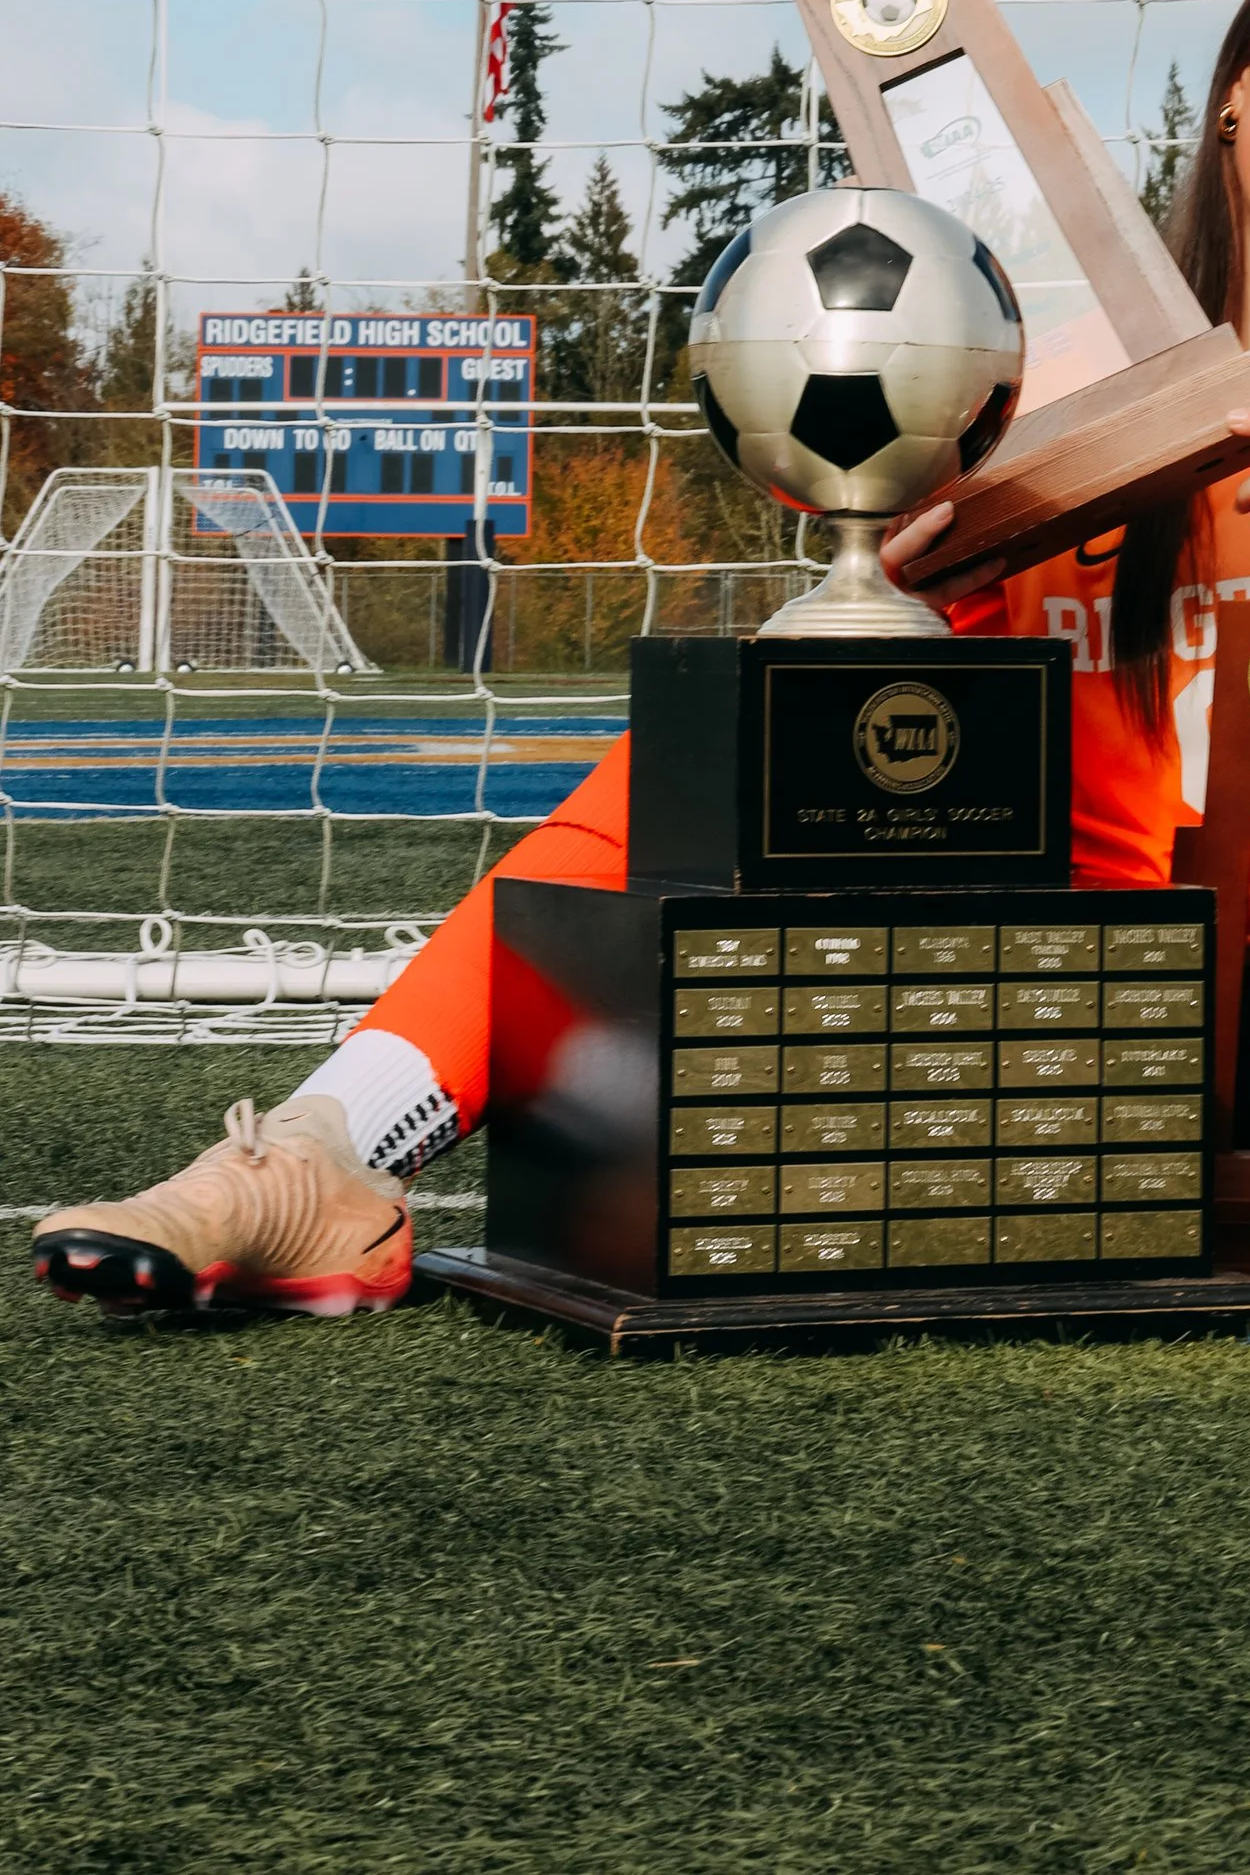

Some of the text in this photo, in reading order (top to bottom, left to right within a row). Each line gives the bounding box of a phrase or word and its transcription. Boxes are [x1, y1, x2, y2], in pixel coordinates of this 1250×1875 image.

[205, 319, 528, 347] RIDGEFIELD HIGH SCHOOL
[200, 355, 274, 378] SPUDDERS
[461, 358, 528, 380] GUEST
[224, 428, 284, 450] DOWN
[294, 429, 352, 450] TO GO
[374, 429, 446, 451] BALL ON
[798, 809, 847, 822] STATE
[857, 809, 877, 822] 2A
[948, 808, 1014, 822] SOCCER
[864, 826, 947, 840] CHAMPION
